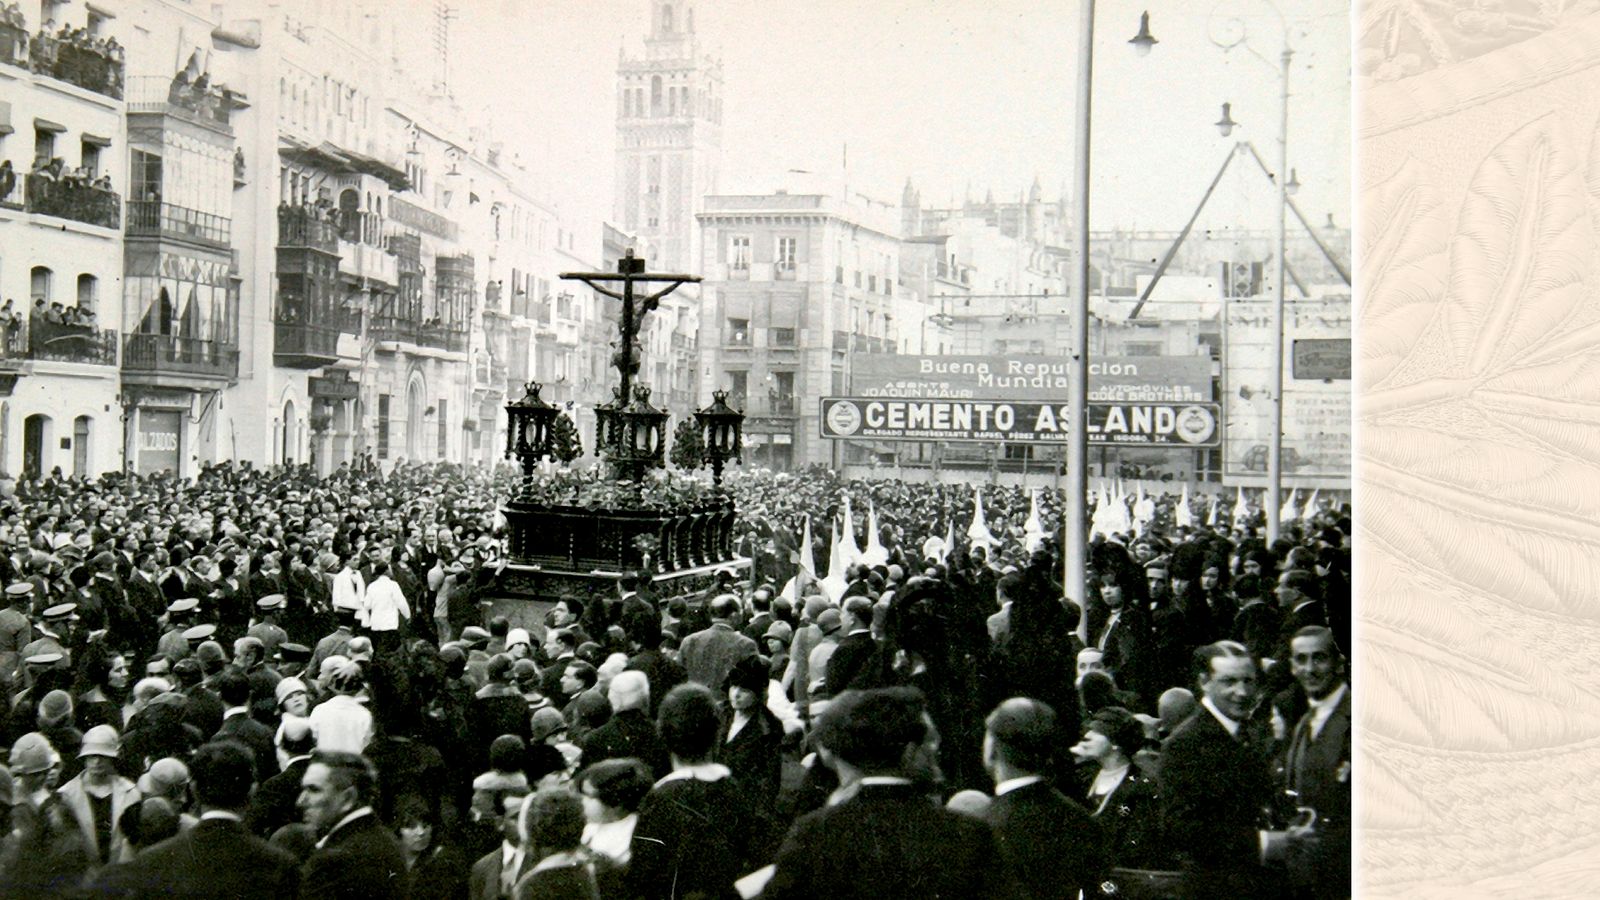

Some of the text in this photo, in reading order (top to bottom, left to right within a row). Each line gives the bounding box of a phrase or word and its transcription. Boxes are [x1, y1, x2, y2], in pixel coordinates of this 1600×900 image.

[919, 359, 1137, 379] Buena Reputcion
[978, 373, 1069, 389] Mundia
[861, 388, 921, 398] JOAQUIN
[1128, 391, 1202, 402] BROTHERS
[865, 402, 1016, 432] CEMENTO
